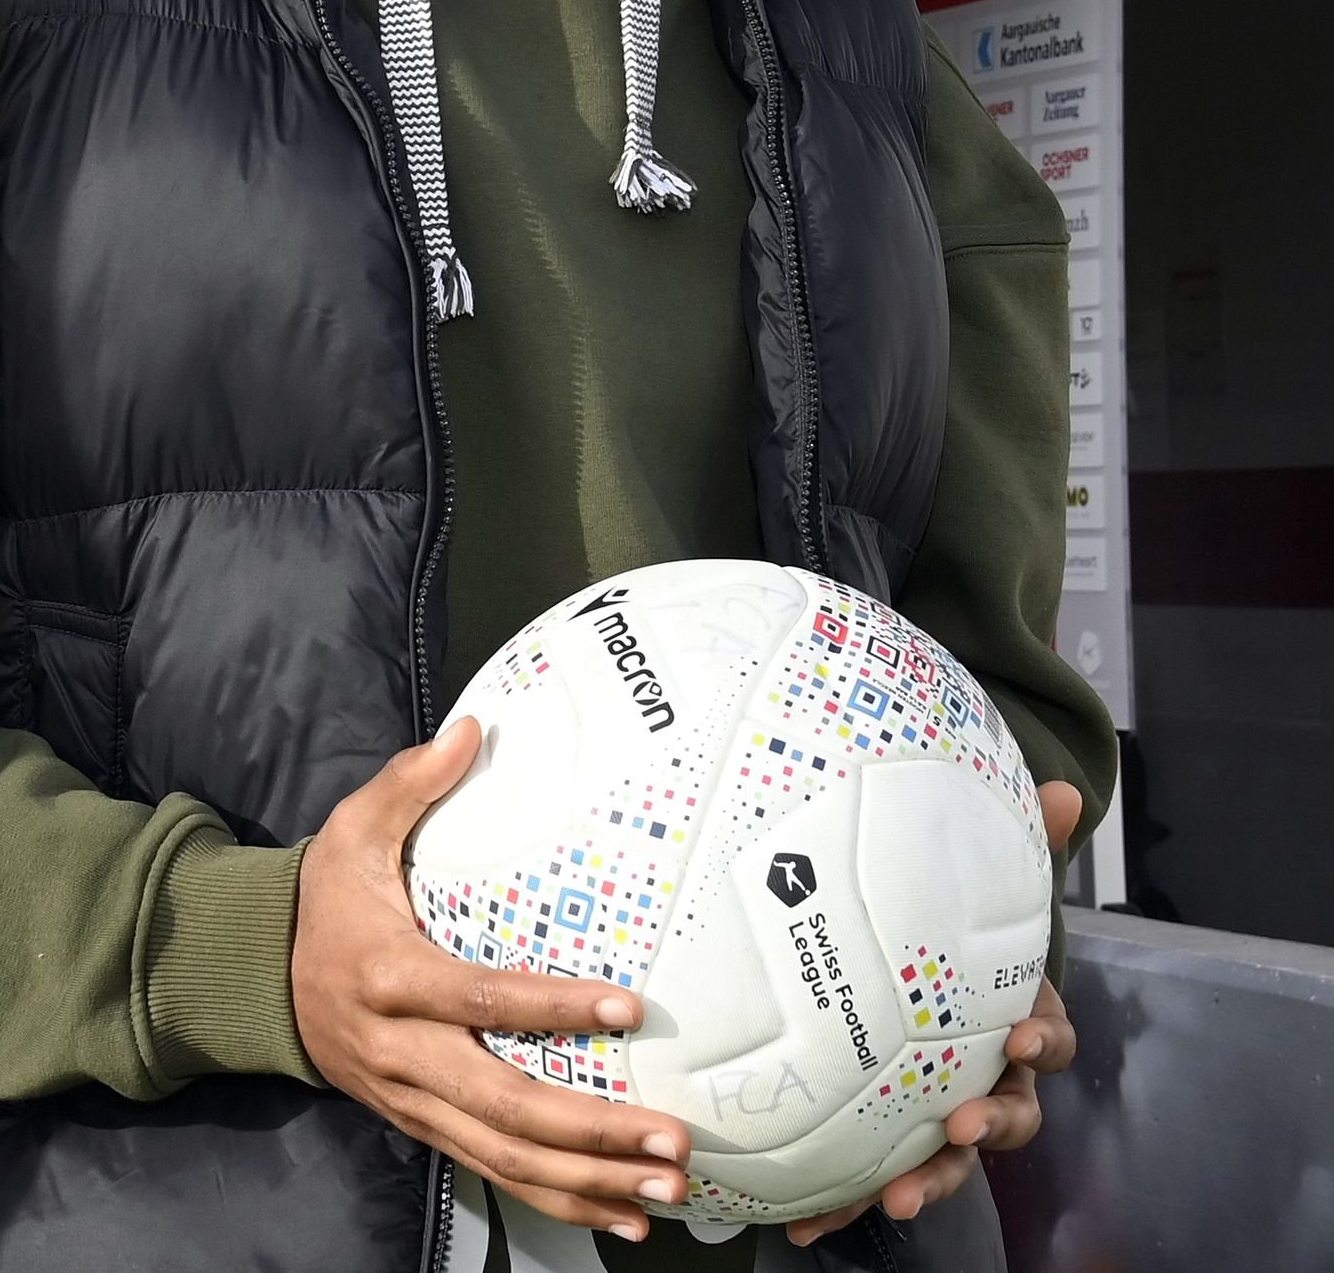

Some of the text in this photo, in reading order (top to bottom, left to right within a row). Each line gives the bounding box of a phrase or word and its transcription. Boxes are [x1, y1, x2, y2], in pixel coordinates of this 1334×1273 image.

[1000, 12, 1061, 44] Aargauische
[999, 30, 1085, 69] Kantonalbank
[1040, 163, 1073, 181] SPORT
[1041, 146, 1090, 166] OCHSNER
[593, 611, 676, 734] macron
[788, 920, 831, 1011] League
[808, 912, 880, 1072] Swiss Football
